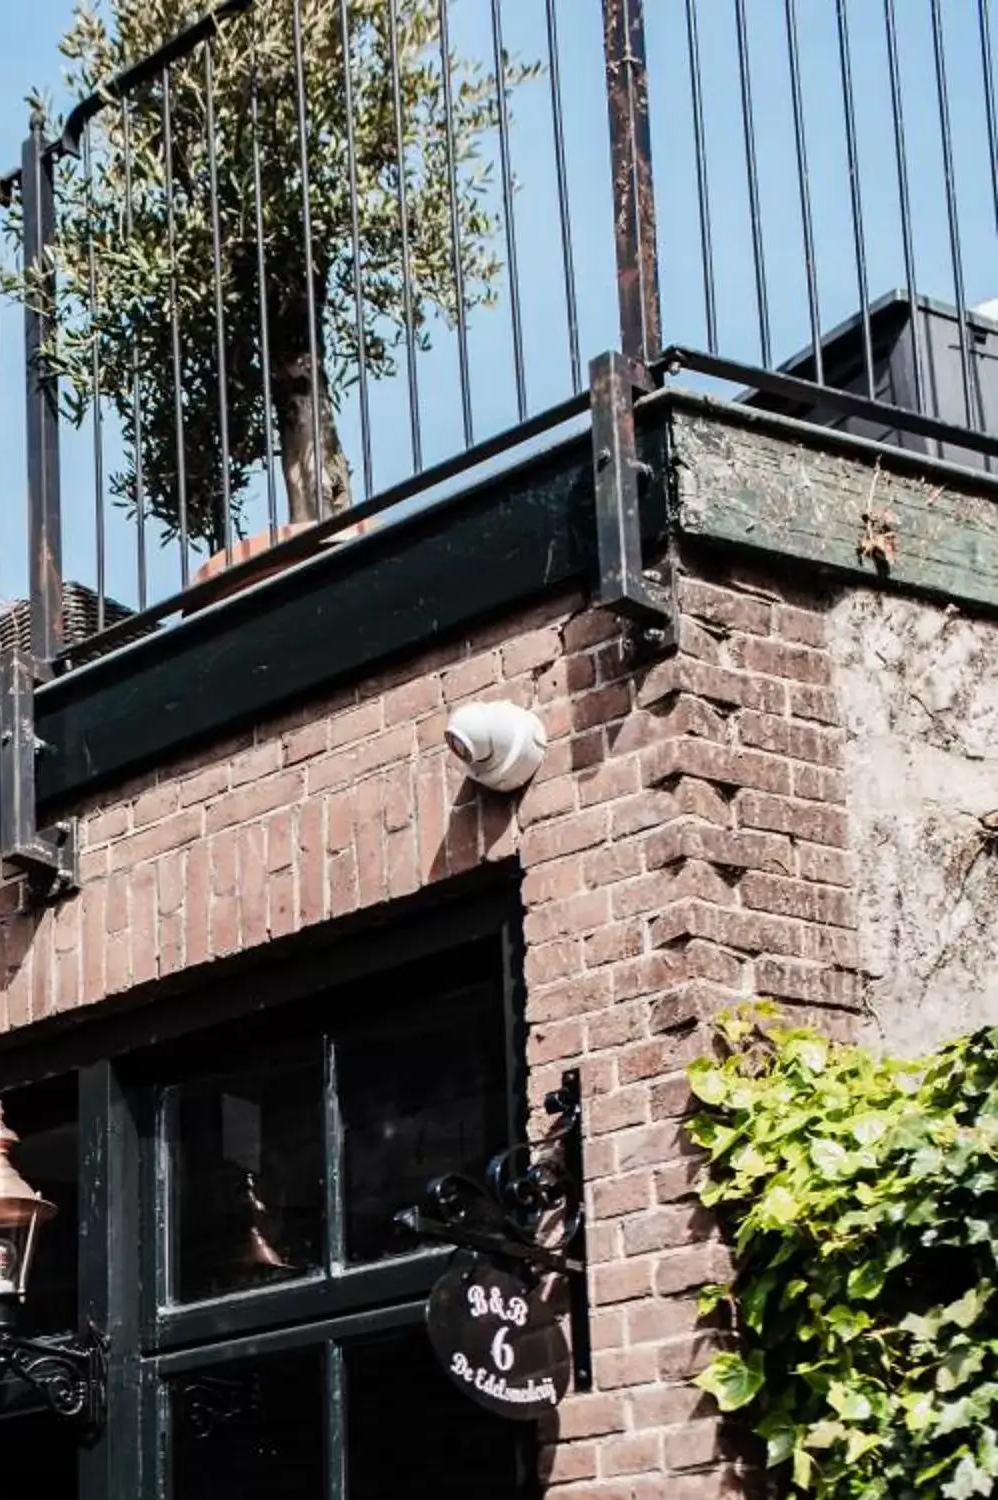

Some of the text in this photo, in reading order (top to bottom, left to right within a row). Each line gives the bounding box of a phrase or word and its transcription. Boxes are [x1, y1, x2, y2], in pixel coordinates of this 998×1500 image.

[467, 1285, 528, 1326] B&B
[450, 1352, 473, 1381] De
[490, 1326, 514, 1371] 6
